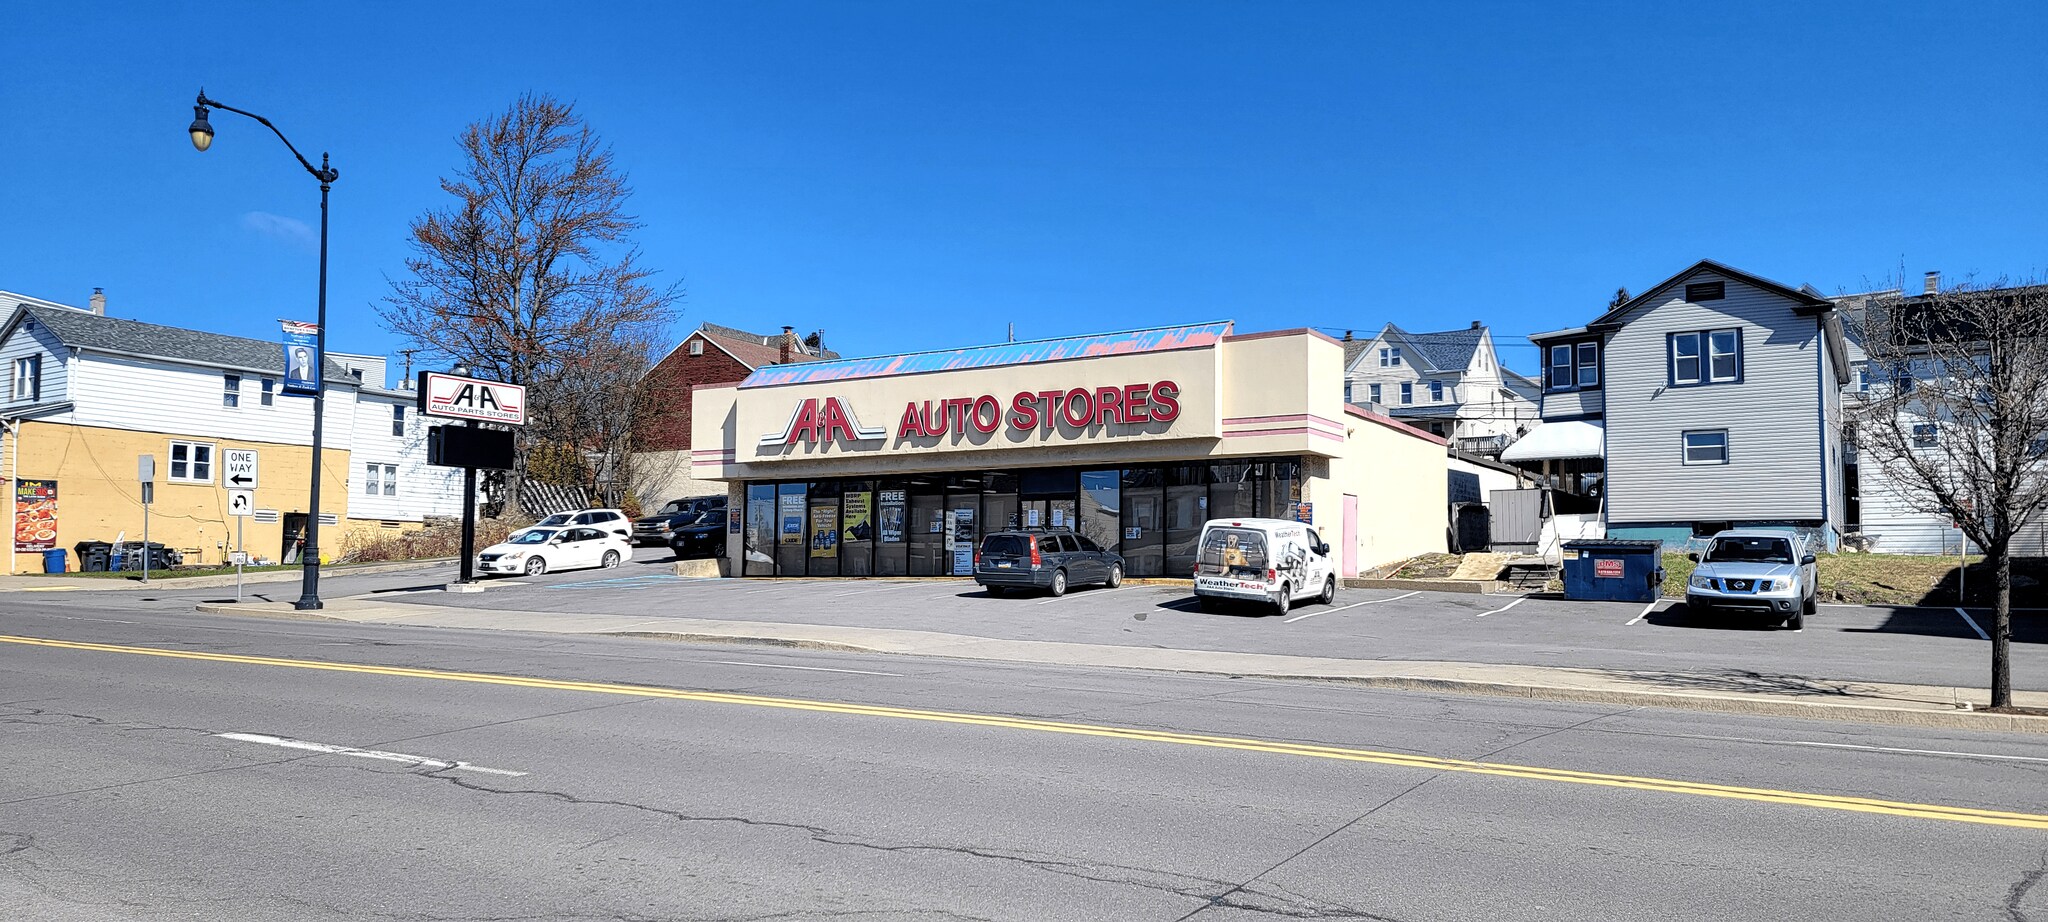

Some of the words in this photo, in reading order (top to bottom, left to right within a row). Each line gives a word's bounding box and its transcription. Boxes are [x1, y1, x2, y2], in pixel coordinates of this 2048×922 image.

[453, 383, 499, 411] A&A
[431, 404, 456, 412] AUTO
[457, 407, 485, 416] PARTS
[486, 409, 520, 420] STORES
[788, 396, 856, 445] A&A
[899, 394, 1001, 438] AUTO
[1011, 380, 1182, 432] STORES
[230, 452, 252, 462] ONE
[230, 463, 253, 473] WAY
[782, 495, 805, 505] FREE
[880, 491, 905, 501] FREE
[1274, 530, 1301, 538] WeatherTech
[1199, 578, 1264, 590] WeatherTech
